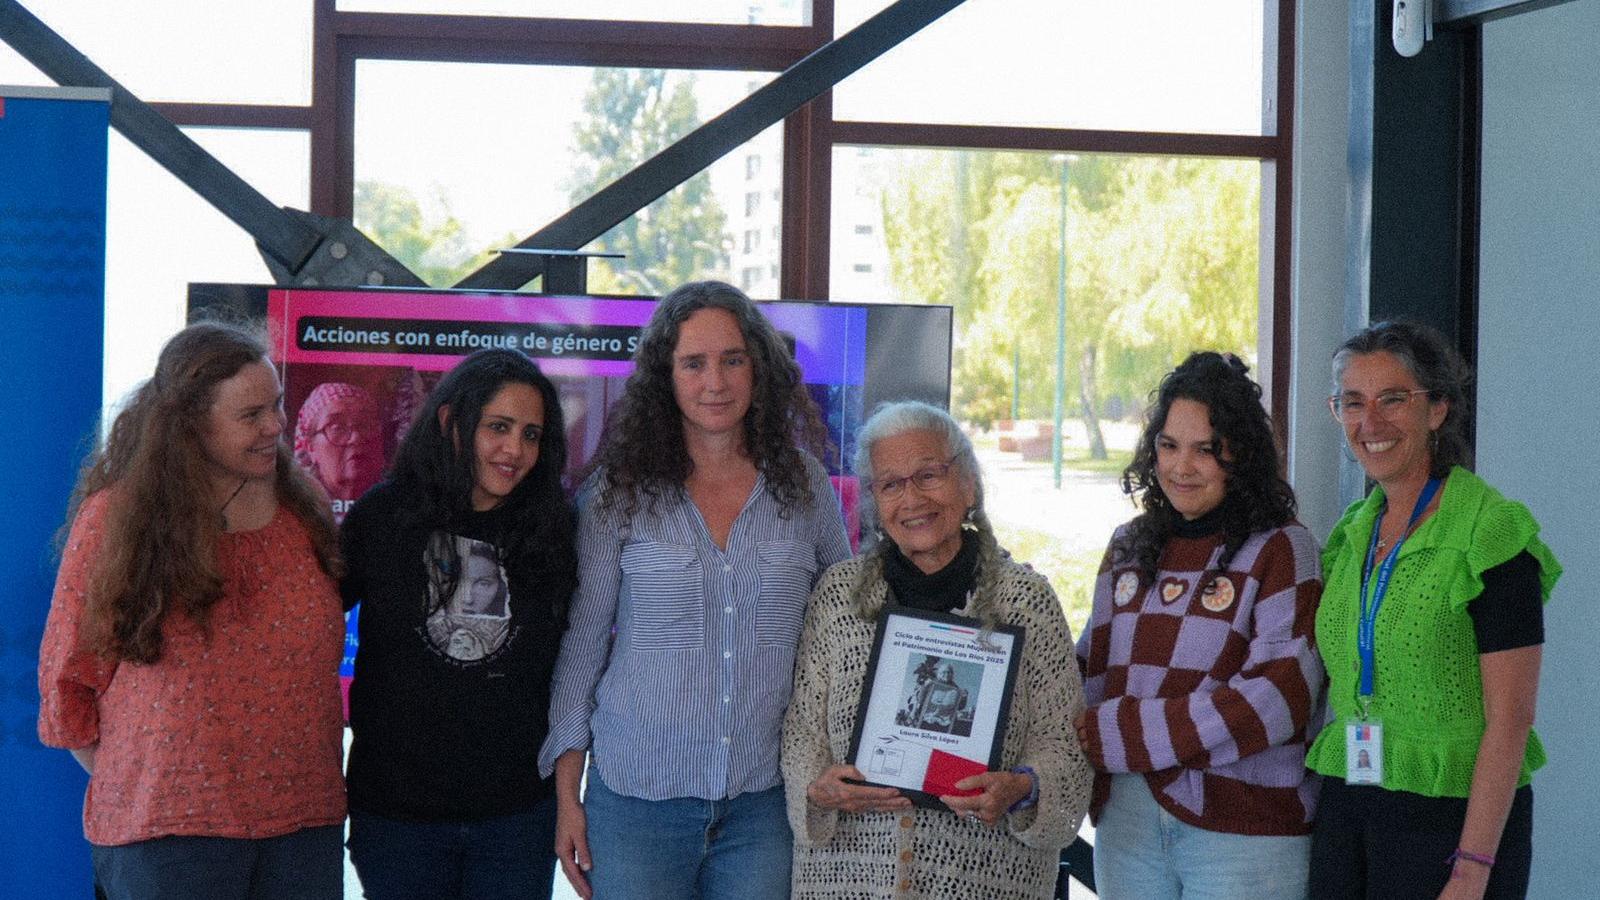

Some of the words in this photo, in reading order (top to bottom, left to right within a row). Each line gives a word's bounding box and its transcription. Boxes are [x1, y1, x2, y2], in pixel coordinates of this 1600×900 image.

[303, 324, 390, 345] Acciones
[395, 330, 430, 346] con
[435, 328, 518, 351] enfoque
[522, 331, 547, 350] de
[551, 331, 621, 355] género
[902, 642, 943, 654] Patrimonio
[944, 648, 953, 656] de
[955, 650, 967, 659] Los
[985, 655, 1005, 665] 2025
